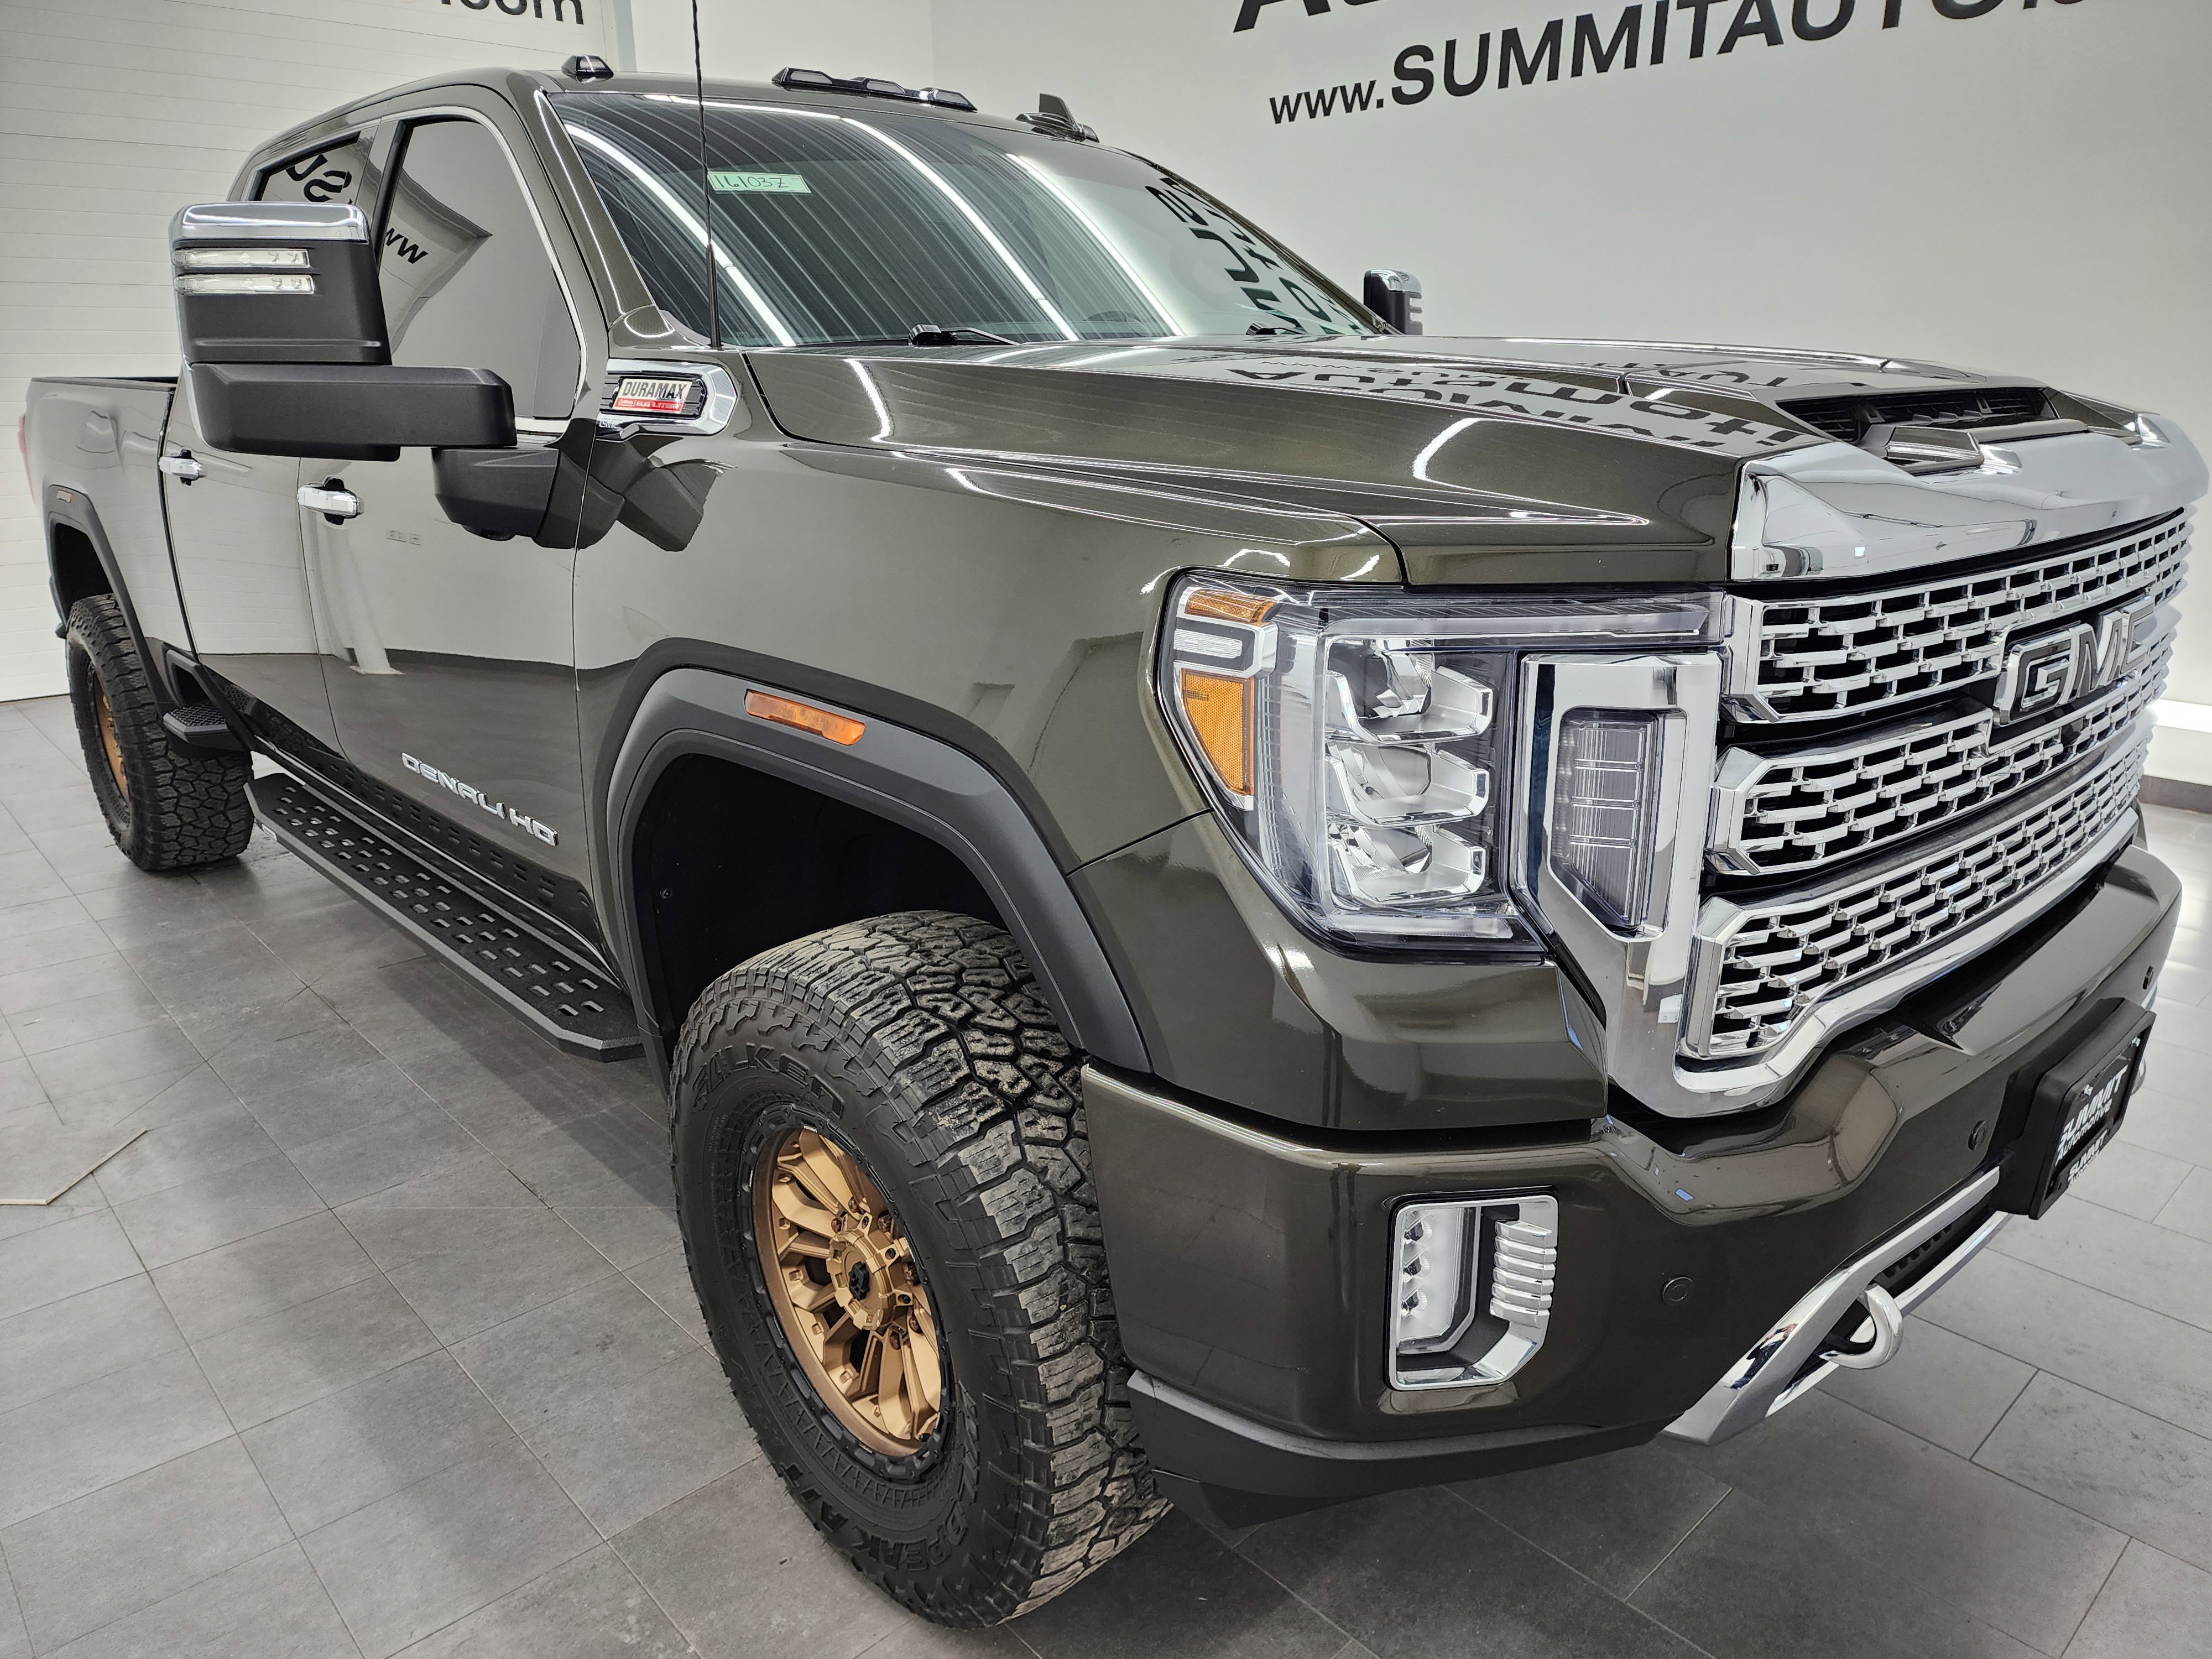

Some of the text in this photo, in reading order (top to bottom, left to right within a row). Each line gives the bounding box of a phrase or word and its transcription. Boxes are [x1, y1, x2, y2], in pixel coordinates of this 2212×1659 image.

[622, 381, 687, 399] DURAMAX
[1995, 598, 2156, 728] GMC
[401, 752, 558, 847] DENALI HD
[2057, 1065, 2129, 1152] SUMMIT
